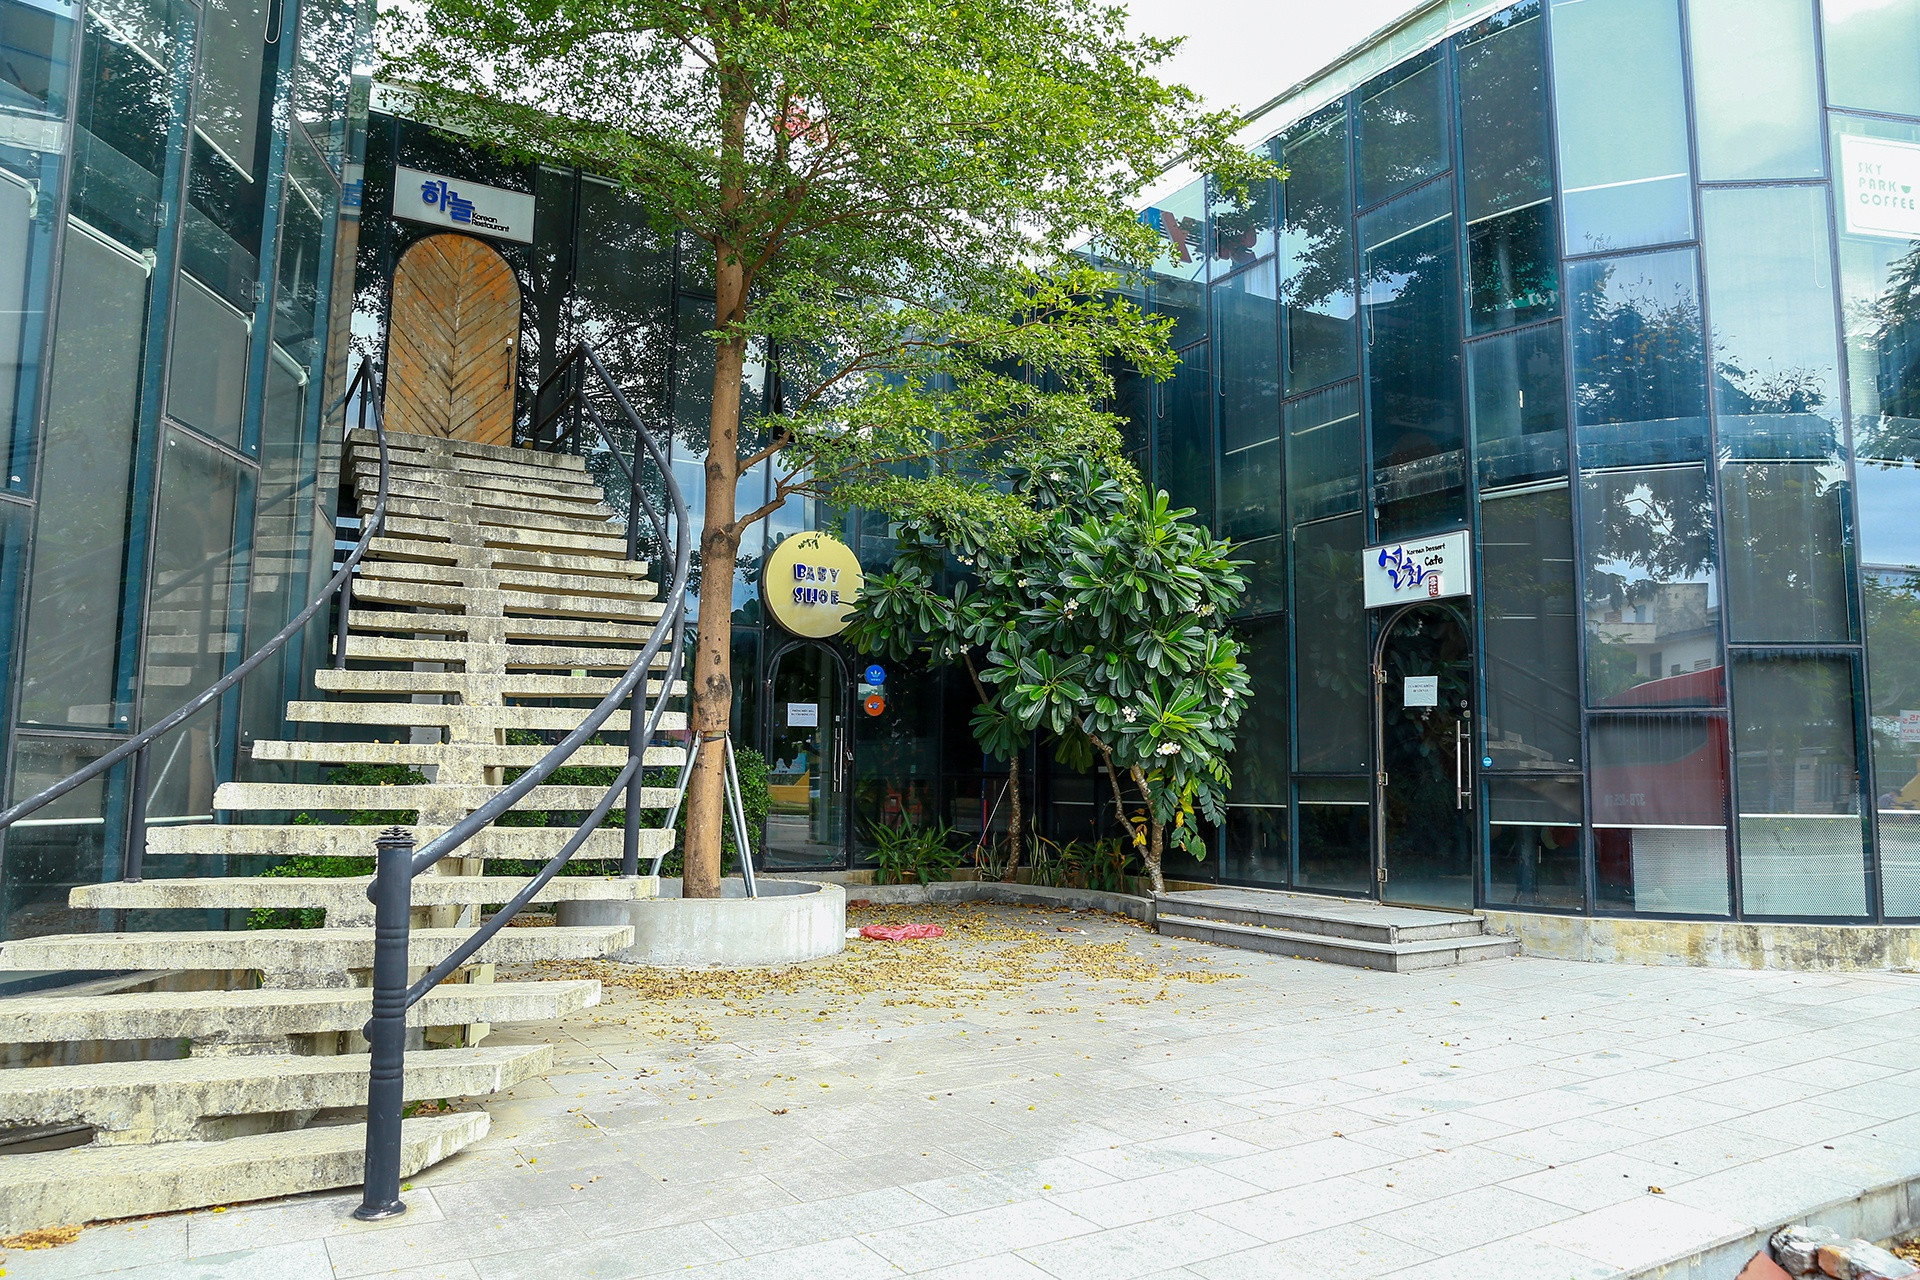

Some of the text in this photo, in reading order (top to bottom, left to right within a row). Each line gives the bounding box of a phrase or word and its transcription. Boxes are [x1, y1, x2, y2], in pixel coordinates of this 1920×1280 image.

[1858, 162, 1882, 175] SKY
[1859, 177, 1896, 192] PARK
[421, 180, 475, 223] 하늘
[1860, 193, 1915, 210] COFFEE
[471, 219, 510, 232] Restaurant
[472, 212, 498, 224] Korean
[1406, 543, 1446, 555] Korean Dessert
[1378, 544, 1442, 590] 설화
[1424, 554, 1444, 566] Cafe
[793, 563, 841, 583] BABY
[793, 587, 840, 605] SHOE
